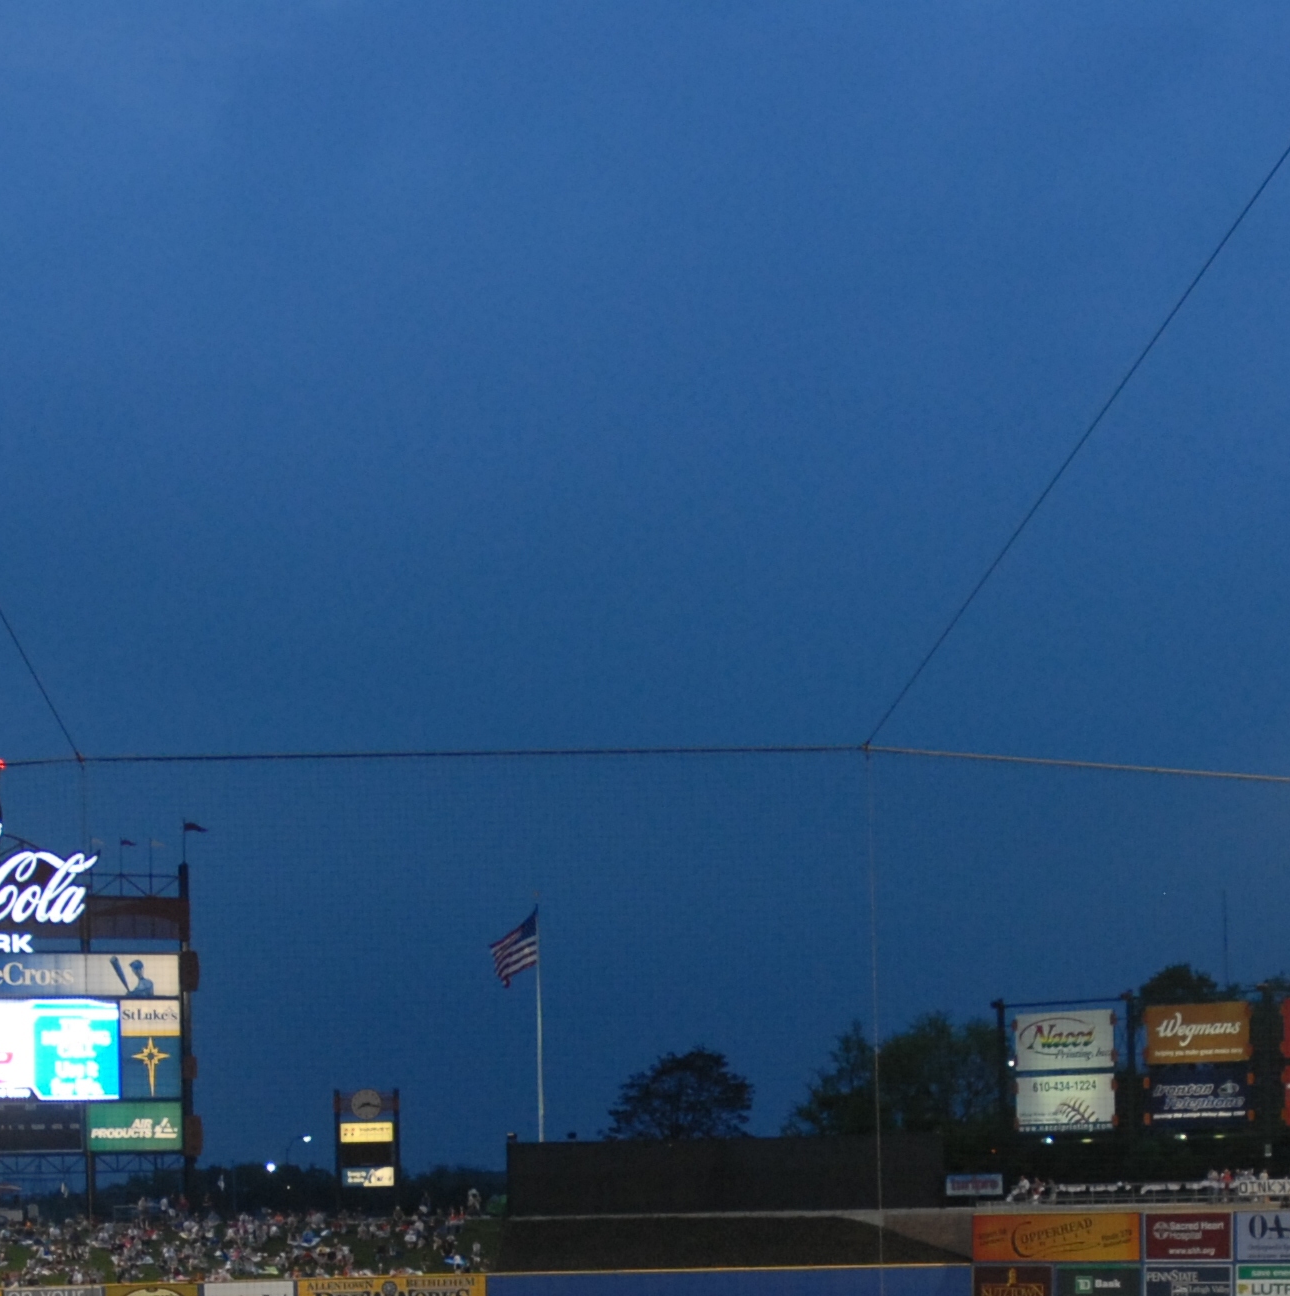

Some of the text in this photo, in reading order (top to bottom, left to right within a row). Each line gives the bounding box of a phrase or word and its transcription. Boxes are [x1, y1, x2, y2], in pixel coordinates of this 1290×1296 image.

[1156, 1012, 1241, 1046] Wegmans
[1033, 1080, 1096, 1092] 610-434-1224
[1154, 1084, 1214, 1096] Ironton
[132, 1118, 153, 1129] AIR
[91, 1127, 153, 1139] PRODUCTS
[1169, 1221, 1224, 1231] Sacred Heart
[1170, 1230, 1203, 1240] Hospital
[307, 1277, 476, 1291] ALLENTOWN BETHLEHEM
[1078, 1278, 1121, 1291] TD Bank
